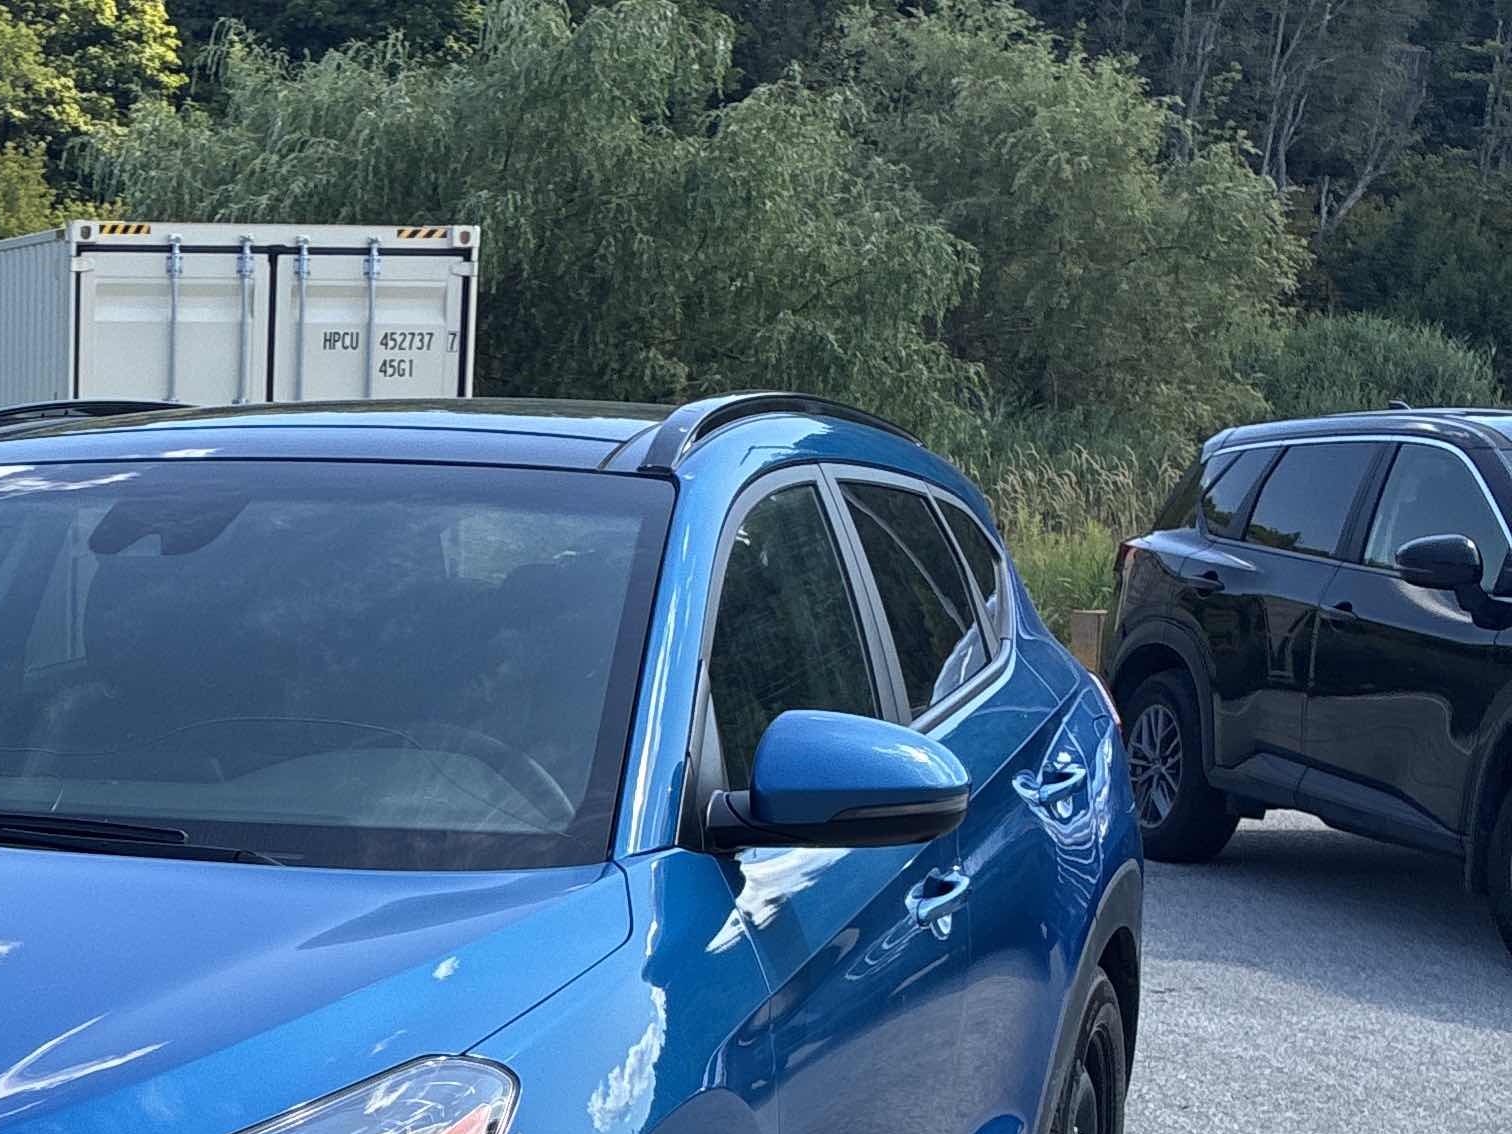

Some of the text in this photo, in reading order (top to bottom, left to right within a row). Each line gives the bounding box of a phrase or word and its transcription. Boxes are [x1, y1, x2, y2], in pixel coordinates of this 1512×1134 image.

[322, 331, 457, 351] HPCU 452737 7
[378, 358, 414, 378] 45G1
